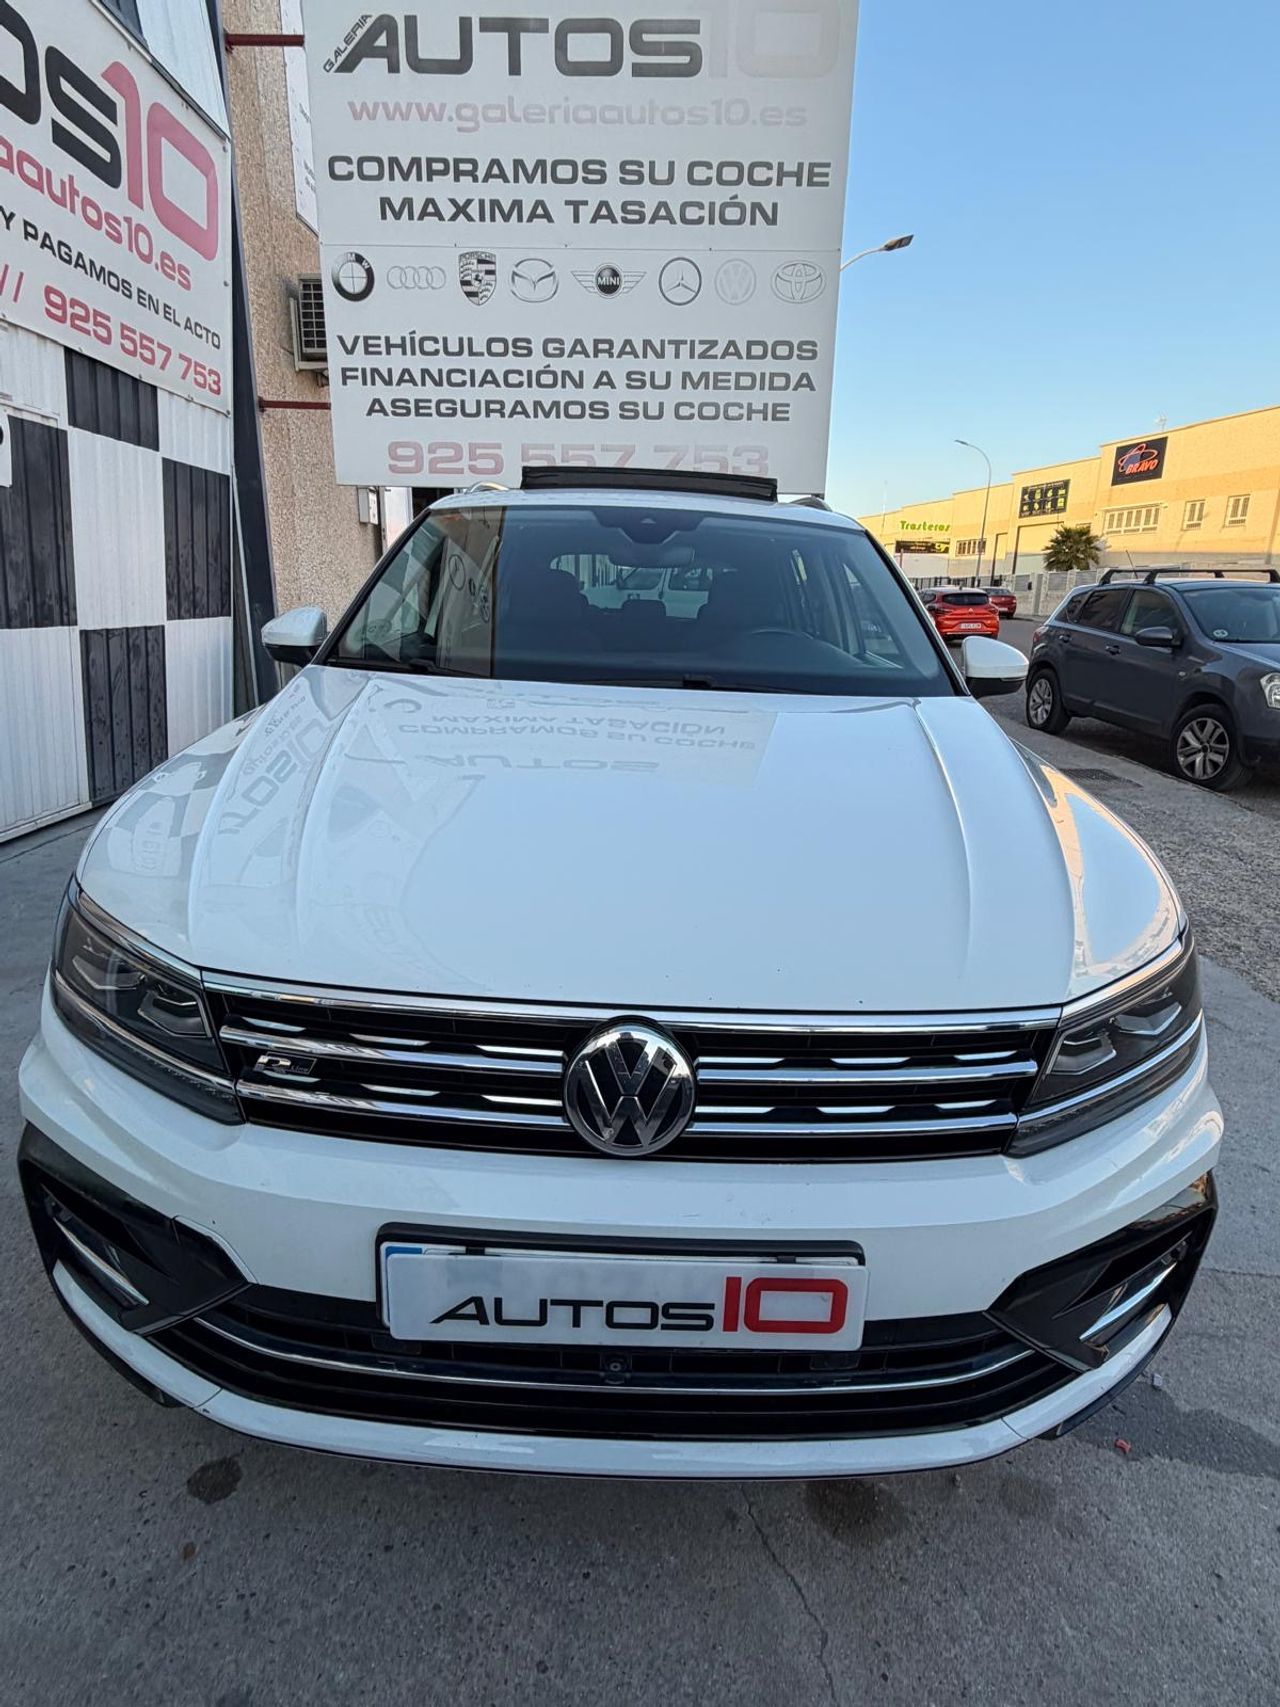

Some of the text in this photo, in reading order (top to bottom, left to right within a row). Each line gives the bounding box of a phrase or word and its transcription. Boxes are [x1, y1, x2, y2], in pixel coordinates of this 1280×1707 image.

[323, 14, 373, 73] GALERIA
[347, 95, 807, 133] www.galeriaautos10.es
[328, 155, 607, 185] COMPRAMOS
[618, 160, 675, 186] SU
[687, 161, 831, 187] COCHE
[379, 194, 778, 226] MAXIMA TASACIÓN
[23, 218, 133, 299] PAGAMOS
[137, 287, 159, 315] EN
[163, 303, 180, 327] EL
[184, 317, 221, 350] ACTO
[597, 276, 620, 286] MINI
[44, 284, 113, 346] 925
[120, 322, 172, 371] 557
[179, 353, 221, 396] 753
[336, 331, 819, 361] VEHÍCULOS GARANTIZADOS
[341, 364, 816, 391] FINANCIACIÓN A SU MEDIDA
[366, 398, 790, 421] ASEGURAMOS SU COCHE
[388, 441, 504, 475] 925
[1125, 459, 1159, 475] BRAVO
[900, 520, 952, 532] Trasteros
